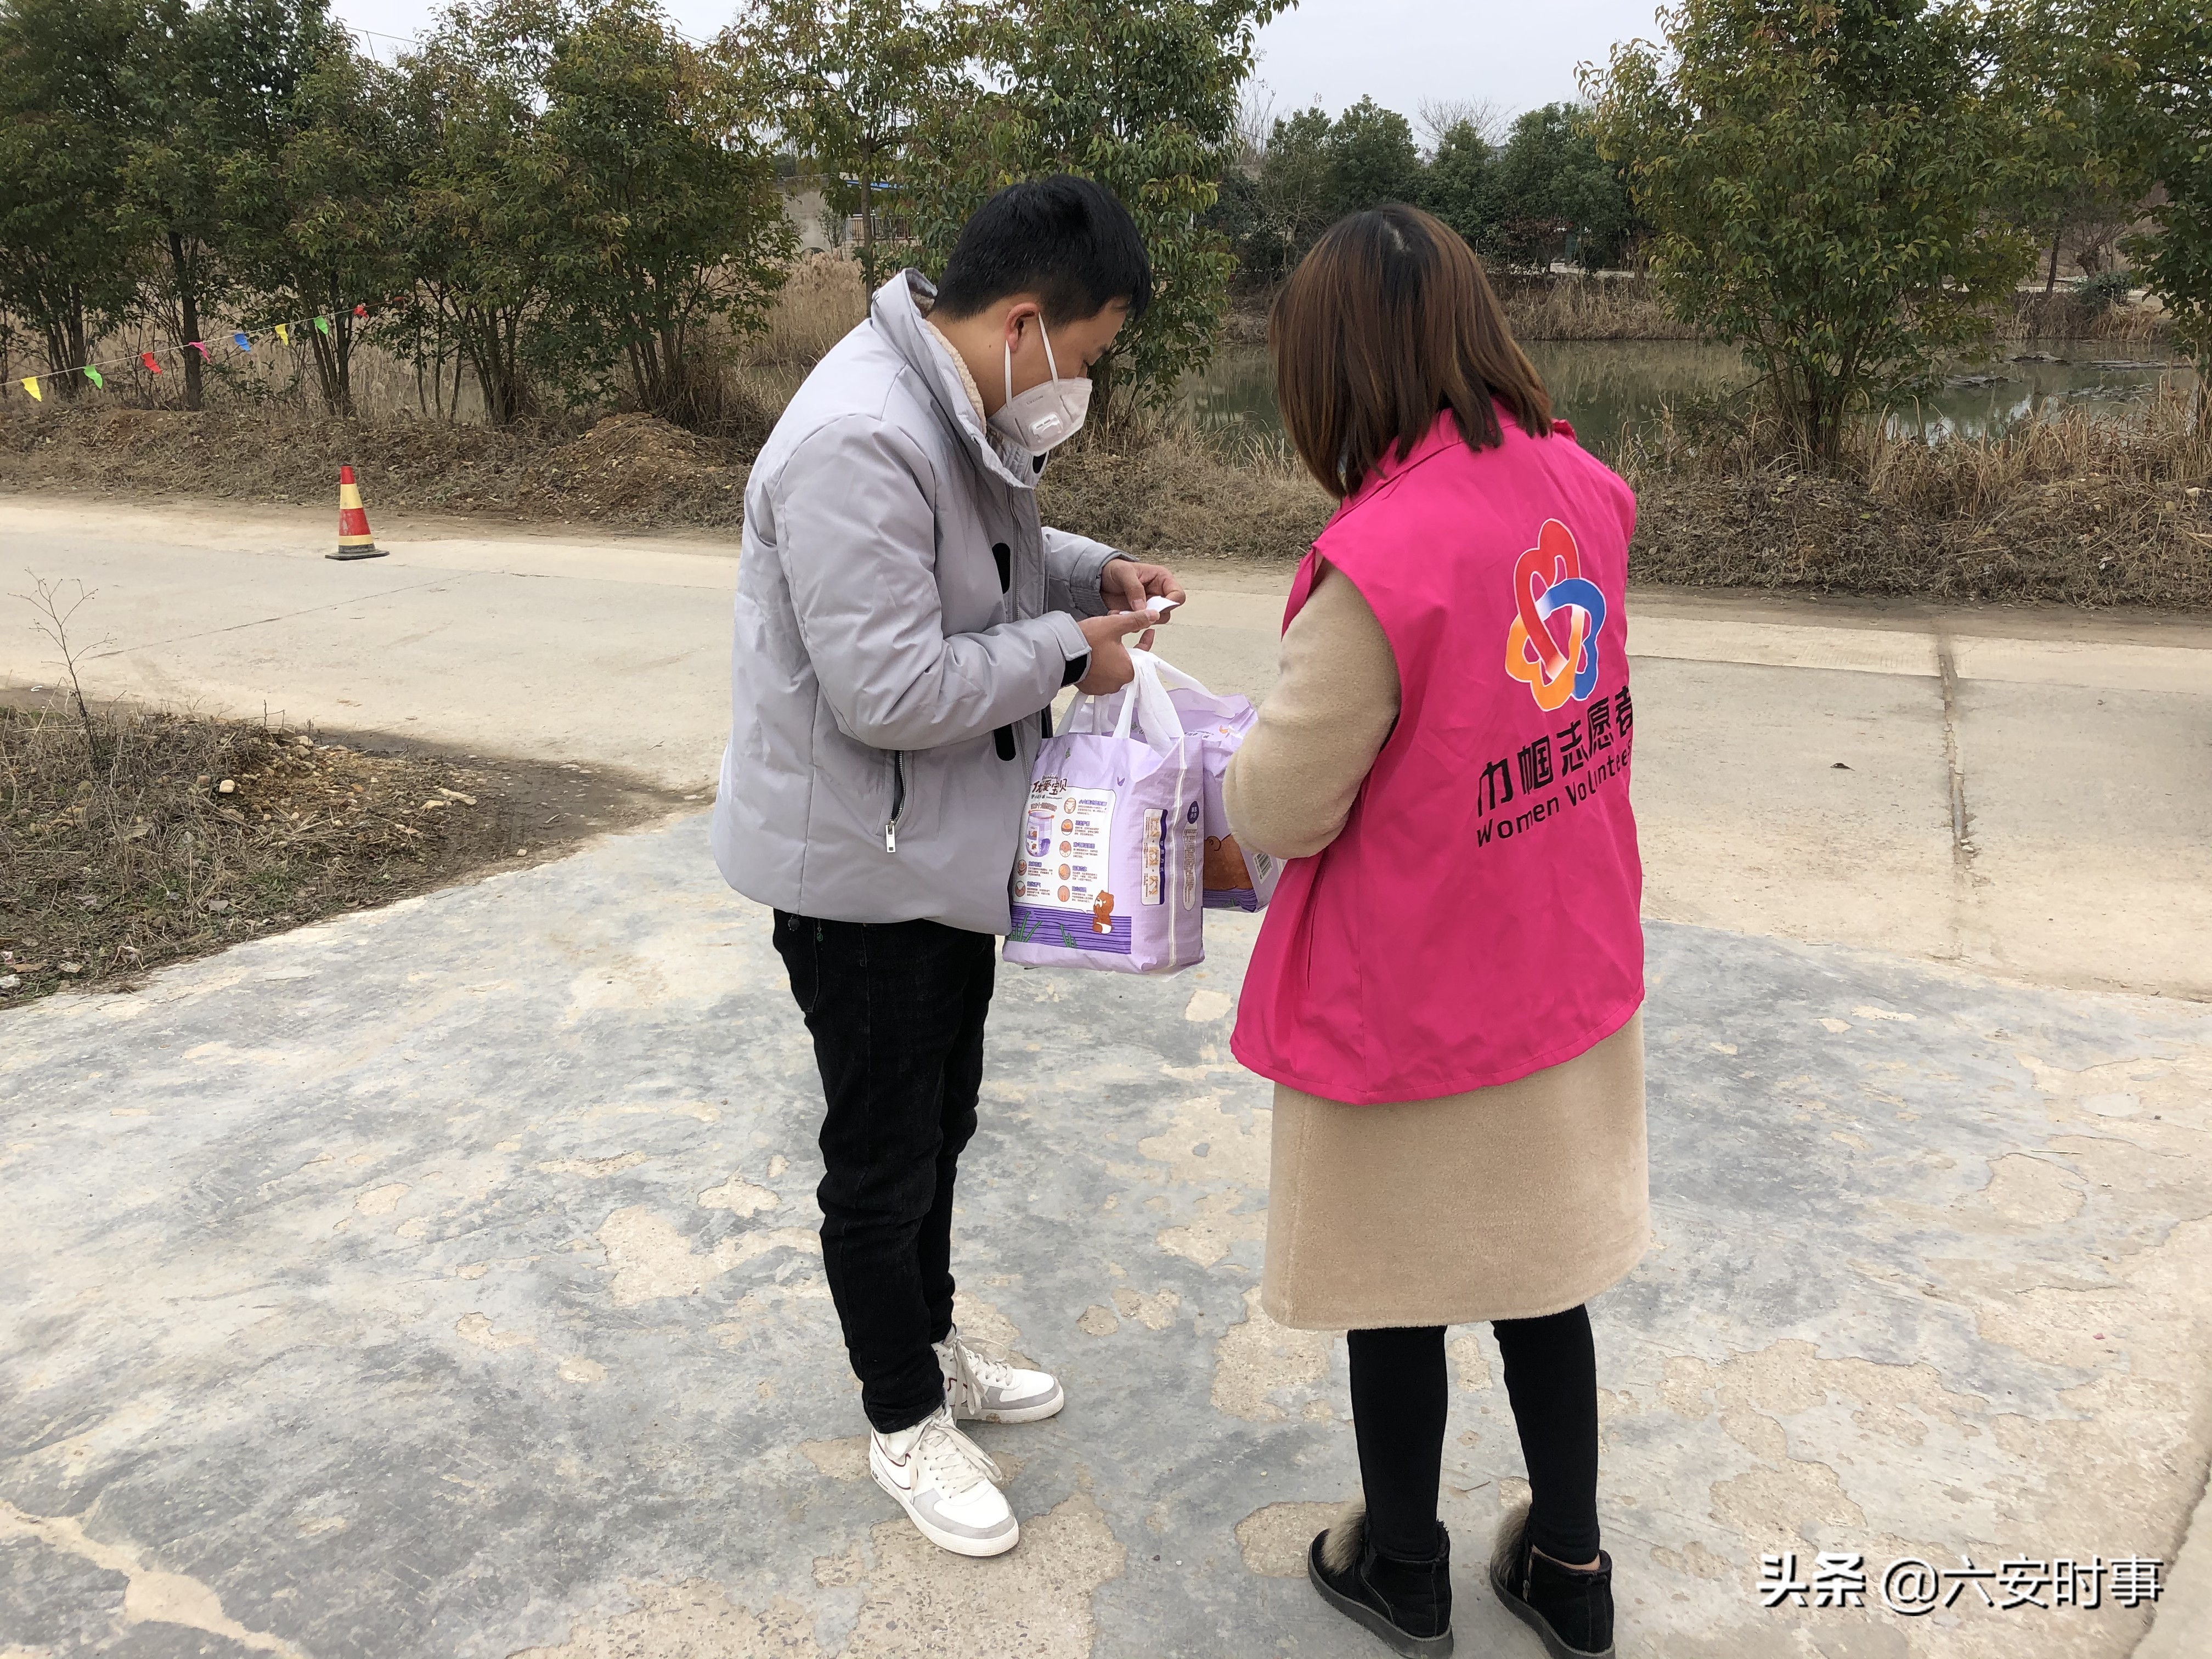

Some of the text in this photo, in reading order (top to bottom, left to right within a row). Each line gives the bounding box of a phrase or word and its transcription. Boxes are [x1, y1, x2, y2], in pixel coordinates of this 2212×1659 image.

[1477, 685, 1633, 817] 巾帼志愿者
[1476, 796, 1560, 848] Women
